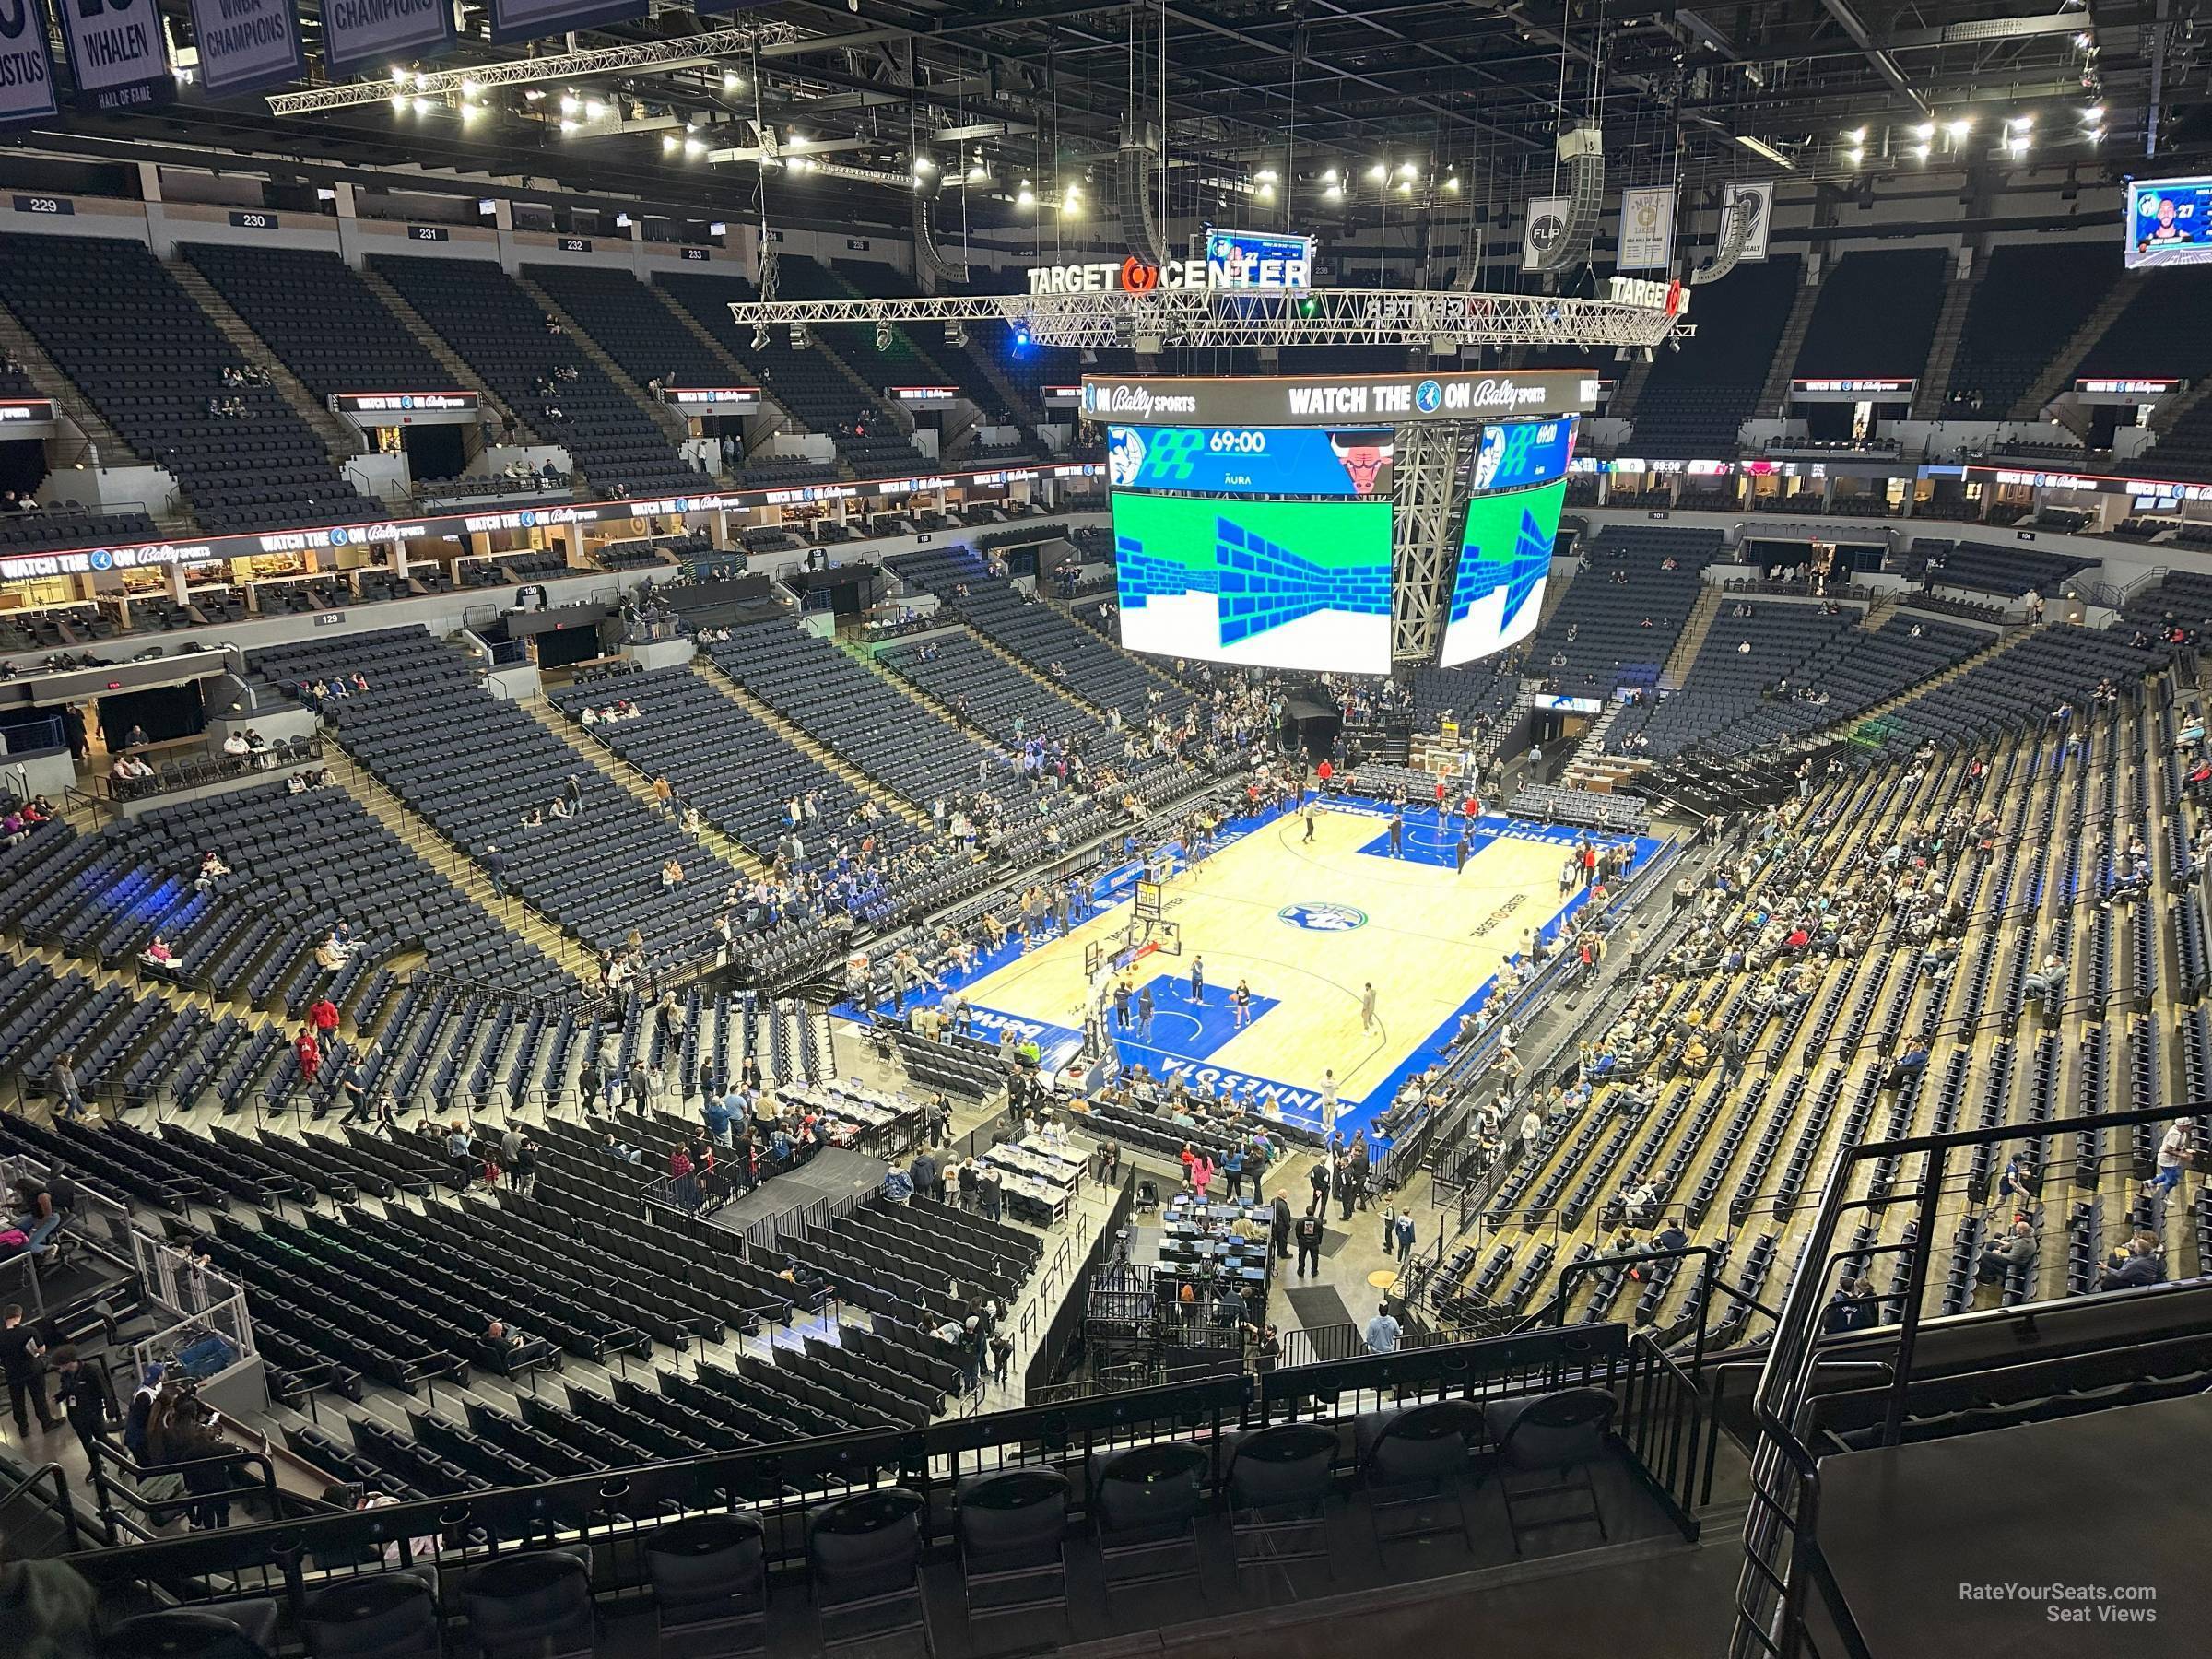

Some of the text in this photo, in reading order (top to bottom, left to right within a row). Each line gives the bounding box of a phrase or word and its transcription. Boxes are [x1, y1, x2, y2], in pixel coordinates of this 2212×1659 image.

[83, 22, 149, 67] WHALEN
[206, 13, 285, 58] CHAMPIONS
[99, 85, 152, 109] HALL OF FAME
[30, 198, 57, 213] 229
[2178, 204, 2194, 218] 27
[243, 214, 265, 228] 230
[419, 228, 437, 241] 231
[567, 240, 582, 251] 232
[688, 249, 702, 259] 233
[1027, 259, 1309, 296] TARGET CENTER
[1608, 276, 1672, 311] TARGET
[1112, 385, 1154, 418] Bally
[1155, 395, 1195, 413] SPORTS
[1289, 379, 1546, 415] WATCH THE ON Bally SPORTS
[1209, 430, 1266, 453] 69:00
[1653, 461, 1681, 471] 69:00
[2126, 480, 2156, 496] WATCH
[2156, 483, 2173, 498] THE
[465, 515, 501, 532] WATCH
[501, 512, 521, 528] THE
[535, 510, 550, 525] ON
[550, 508, 576, 524] Bally
[630, 502, 660, 517] WATCH
[660, 500, 677, 514] THE
[259, 533, 305, 552] WATCH
[305, 531, 331, 548] THE
[347, 527, 368, 544] ON
[368, 524, 401, 542] Bally
[1, 544, 211, 579] WATCH THE ON Bally SPORTS
[524, 586, 537, 595] 130
[322, 614, 338, 624] 129
[1478, 827, 1613, 853] MINNEST
[1468, 893, 1529, 937] TARGET CENTER
[1160, 1057, 1357, 1118] MINNESOTA
